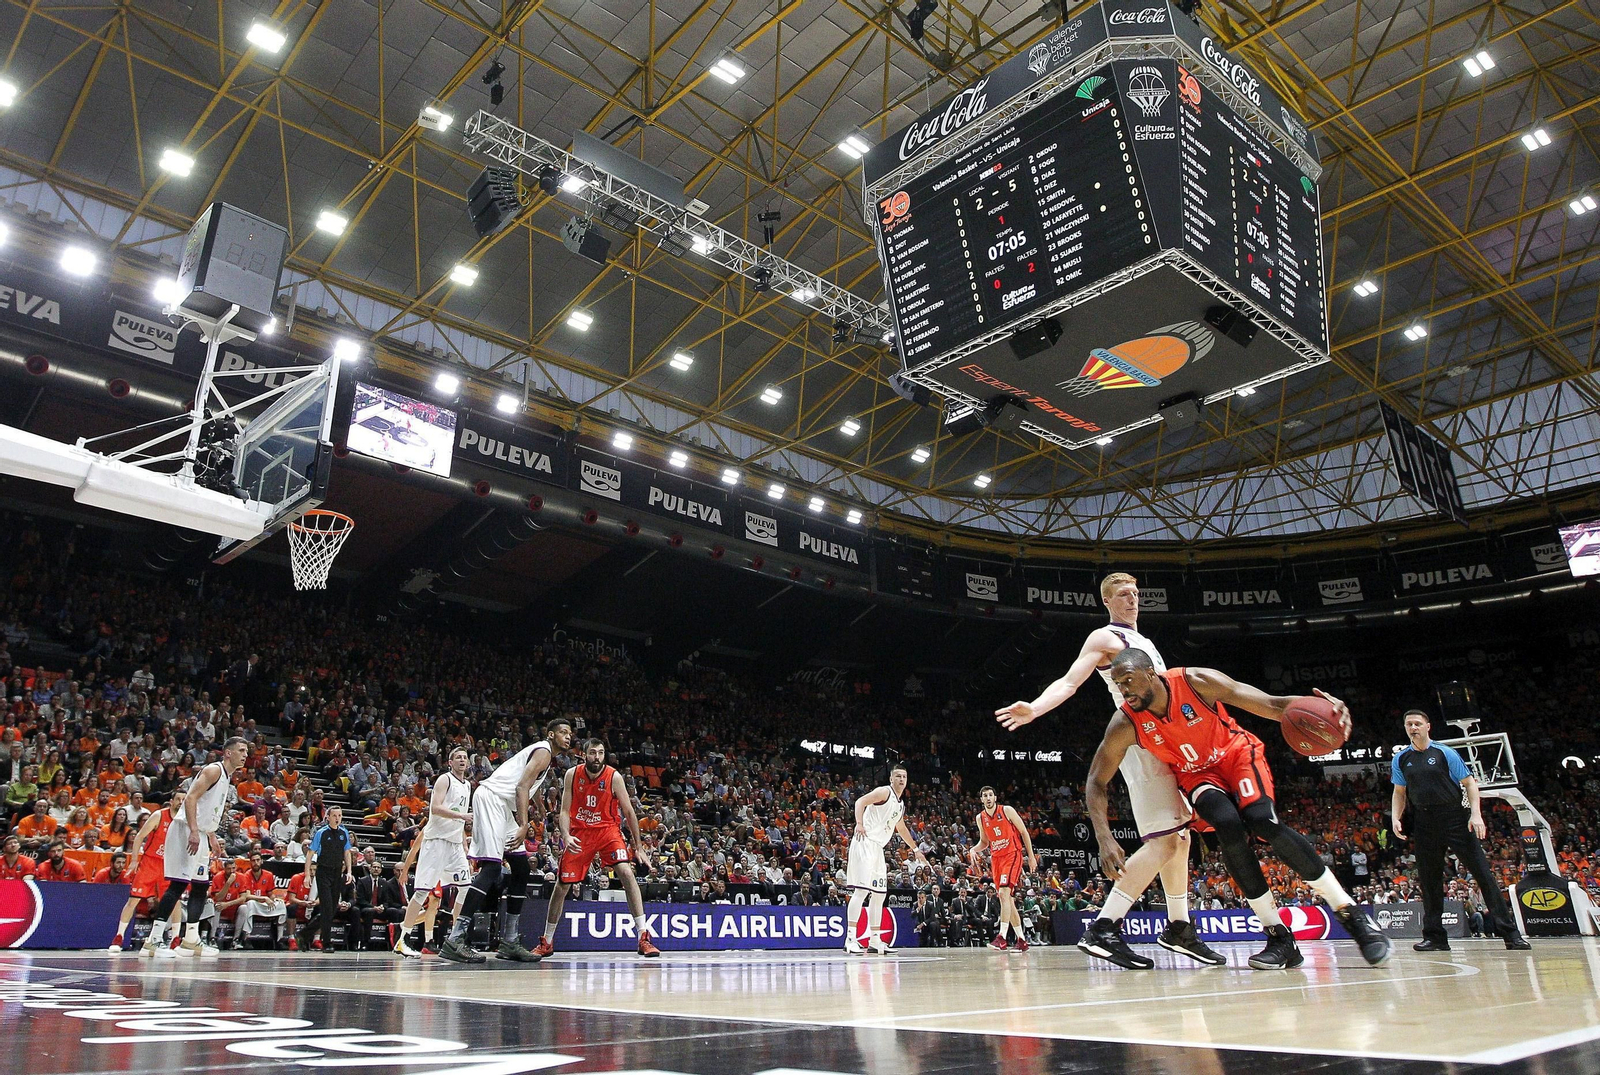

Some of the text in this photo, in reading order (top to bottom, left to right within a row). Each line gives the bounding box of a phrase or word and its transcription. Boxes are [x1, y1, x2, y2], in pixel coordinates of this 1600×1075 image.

[1110, 8, 1166, 25] Coca-Cola
[1049, 20, 1082, 44] valencia
[1050, 32, 1078, 54] basket
[1052, 46, 1072, 62] club
[1201, 37, 1262, 106] Coca-Cola
[1082, 98, 1110, 116] Unicaja
[899, 76, 990, 160] Coca-Cola
[1028, 108, 1117, 163] 2 OKOUO 0
[1135, 132, 1175, 140] Esfuerzo
[1031, 119, 1120, 174] 8 FOGG 0
[932, 174, 957, 191] Valencia
[957, 162, 978, 178] Basket
[996, 137, 1020, 154] Unicaja
[1033, 130, 1122, 185] 9 DIAZ 5
[1044, 180, 1057, 191] DIEZ
[1120, 142, 1126, 150] 0
[969, 164, 1019, 196] LOCAL VISITANT
[1038, 153, 1129, 206] 15 SMITH 0
[976, 179, 1016, 210] 2 5
[1040, 164, 1132, 217] 16 NEDOVIC 0
[988, 201, 1009, 216] PERIODE
[1042, 176, 1135, 229] 20 LAFAYETTE 0
[999, 216, 1004, 224] 1
[1045, 187, 1138, 240] 21 WACZYNSKI 0
[1057, 230, 1082, 247] BROOKS
[1135, 199, 1141, 208] 0
[893, 225, 914, 240] THOMAS
[996, 227, 1012, 238] TEMPS
[1060, 242, 1083, 258] SUAREZ
[1138, 211, 1144, 220] 0
[1247, 222, 1270, 249] 07:05
[895, 240, 906, 250] DIOT
[897, 249, 910, 260] VAN
[908, 239, 929, 256] ROSSOM
[988, 231, 1026, 260] 07:05
[1054, 223, 1147, 274] 44 MUSLI 0
[892, 265, 898, 273] 10
[899, 260, 911, 270] SATO
[985, 248, 1037, 278] FALTES FALTES
[1056, 235, 1150, 286] 92 OMIC 0
[894, 275, 901, 284] 14
[994, 263, 1035, 289] 0 2
[896, 285, 902, 294] 16
[902, 280, 916, 291] VIVES
[898, 295, 905, 304] 17
[905, 284, 930, 301] MARTINEZ
[1002, 285, 1028, 302] Cultura
[900, 298, 925, 314] 18 ORIOLA
[1002, 290, 1036, 310] Esfuerzo
[902, 300, 944, 324] 19 SAN EMETERIO
[116, 316, 174, 344] PULEVA
[904, 319, 929, 335] 30 SASTRE
[906, 326, 940, 346] 42 FERRANDO
[908, 342, 931, 356] 43 SIKMA
[1096, 349, 1158, 386] VALENCIA BASKET
[1027, 392, 1102, 432] Taronja
[460, 428, 552, 474] PULEVA
[583, 465, 619, 484] PULEVA
[649, 486, 722, 526] PULEVA
[747, 515, 776, 531] PULEVA
[799, 532, 858, 564] PULEVA
[968, 576, 996, 587] PULEVA
[1321, 580, 1358, 591] PULEVA
[1402, 564, 1493, 589] PULEVA
[1027, 587, 1097, 607] PULEVA
[1203, 590, 1281, 606] PULEVA
[552, 629, 628, 661] CaixaBank
[1294, 662, 1357, 682] isaval
[1035, 751, 1062, 762] Coca-Cola
[1180, 744, 1198, 762] 0
[1239, 778, 1254, 797] 0
[459, 796, 466, 806] 21
[586, 795, 596, 807] 18
[993, 827, 1002, 836] 16
[616, 849, 627, 860] 18
[462, 870, 470, 881] 21
[1000, 875, 1007, 883] 16
[1530, 891, 1558, 907] AP
[565, 912, 844, 938] TURKISH AIRLINES
